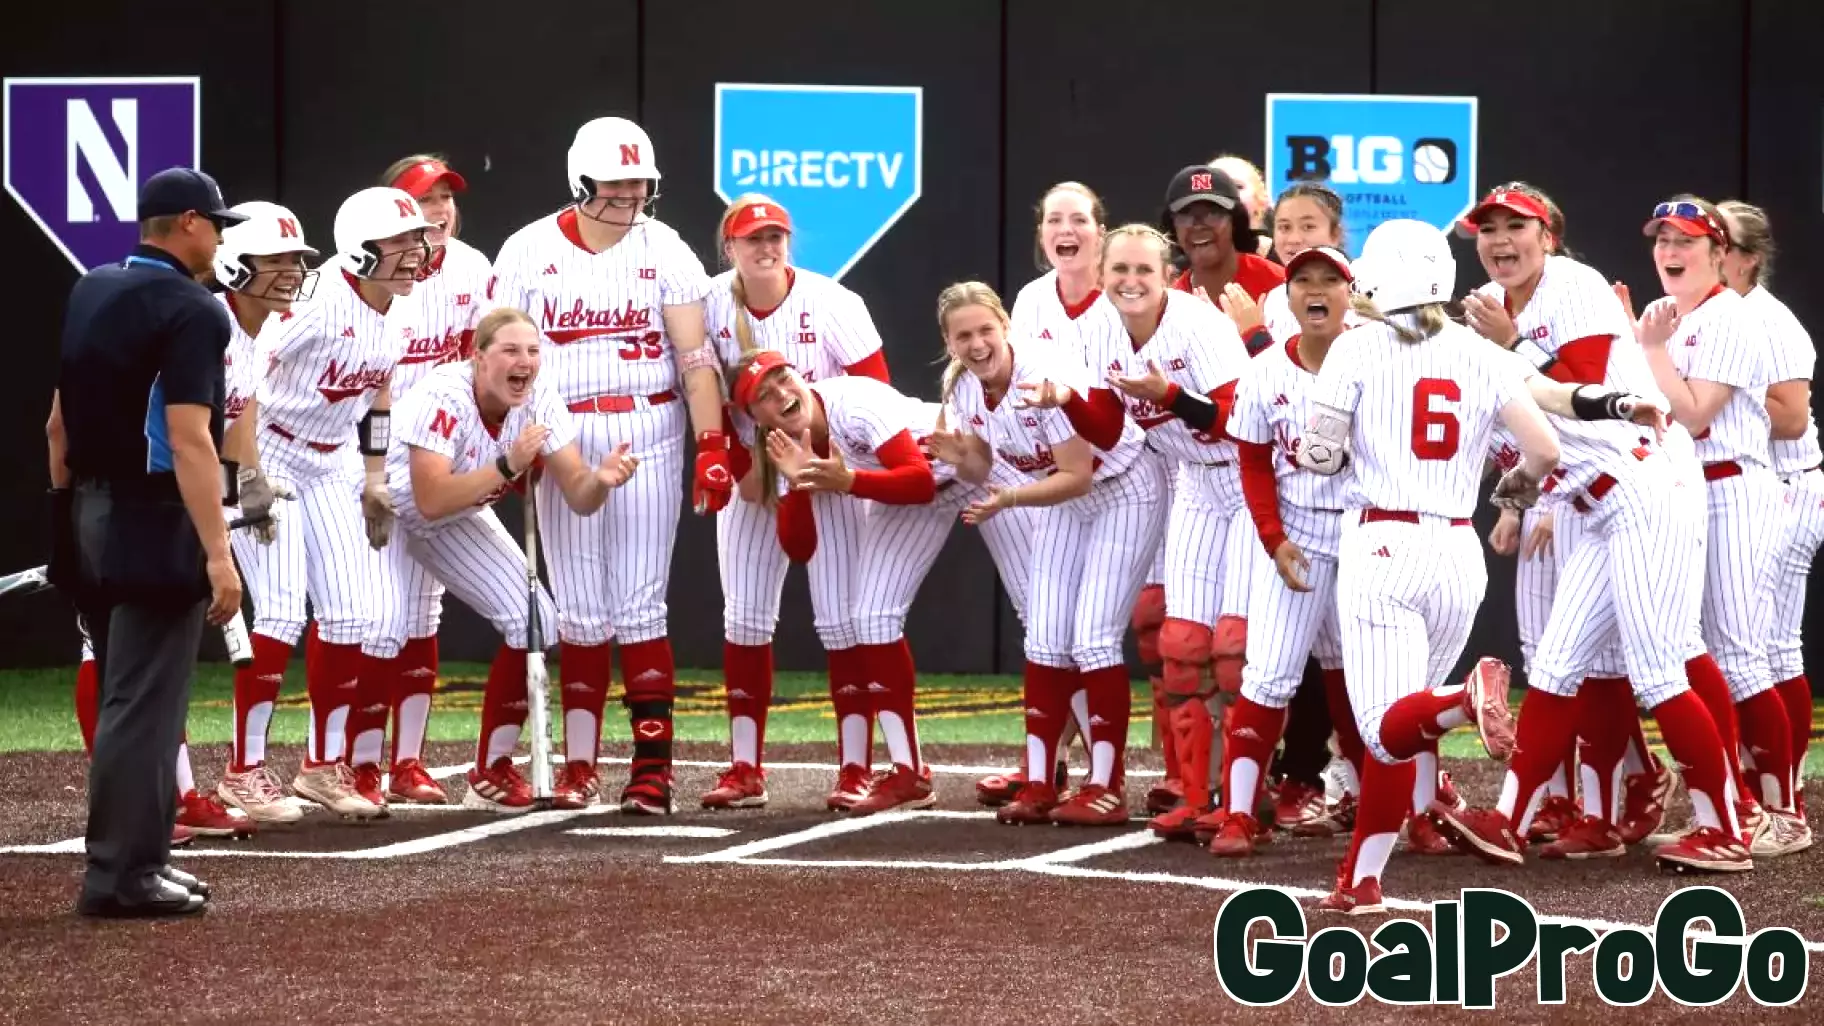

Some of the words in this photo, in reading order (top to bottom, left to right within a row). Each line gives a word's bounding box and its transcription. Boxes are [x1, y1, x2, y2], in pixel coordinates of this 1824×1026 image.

[67, 98, 138, 222] N
[619, 144, 640, 165] N
[731, 149, 904, 188] DIRECTV
[1190, 174, 1212, 190] N
[394, 197, 417, 218] N
[1345, 193, 1406, 205] OFTBALL
[277, 218, 298, 238] N
[1429, 283, 1437, 296] 6
[541, 296, 650, 329] Nebraska
[798, 312, 809, 330] C
[617, 331, 662, 361] 33
[430, 408, 458, 441] N
[1411, 377, 1461, 461] 6
